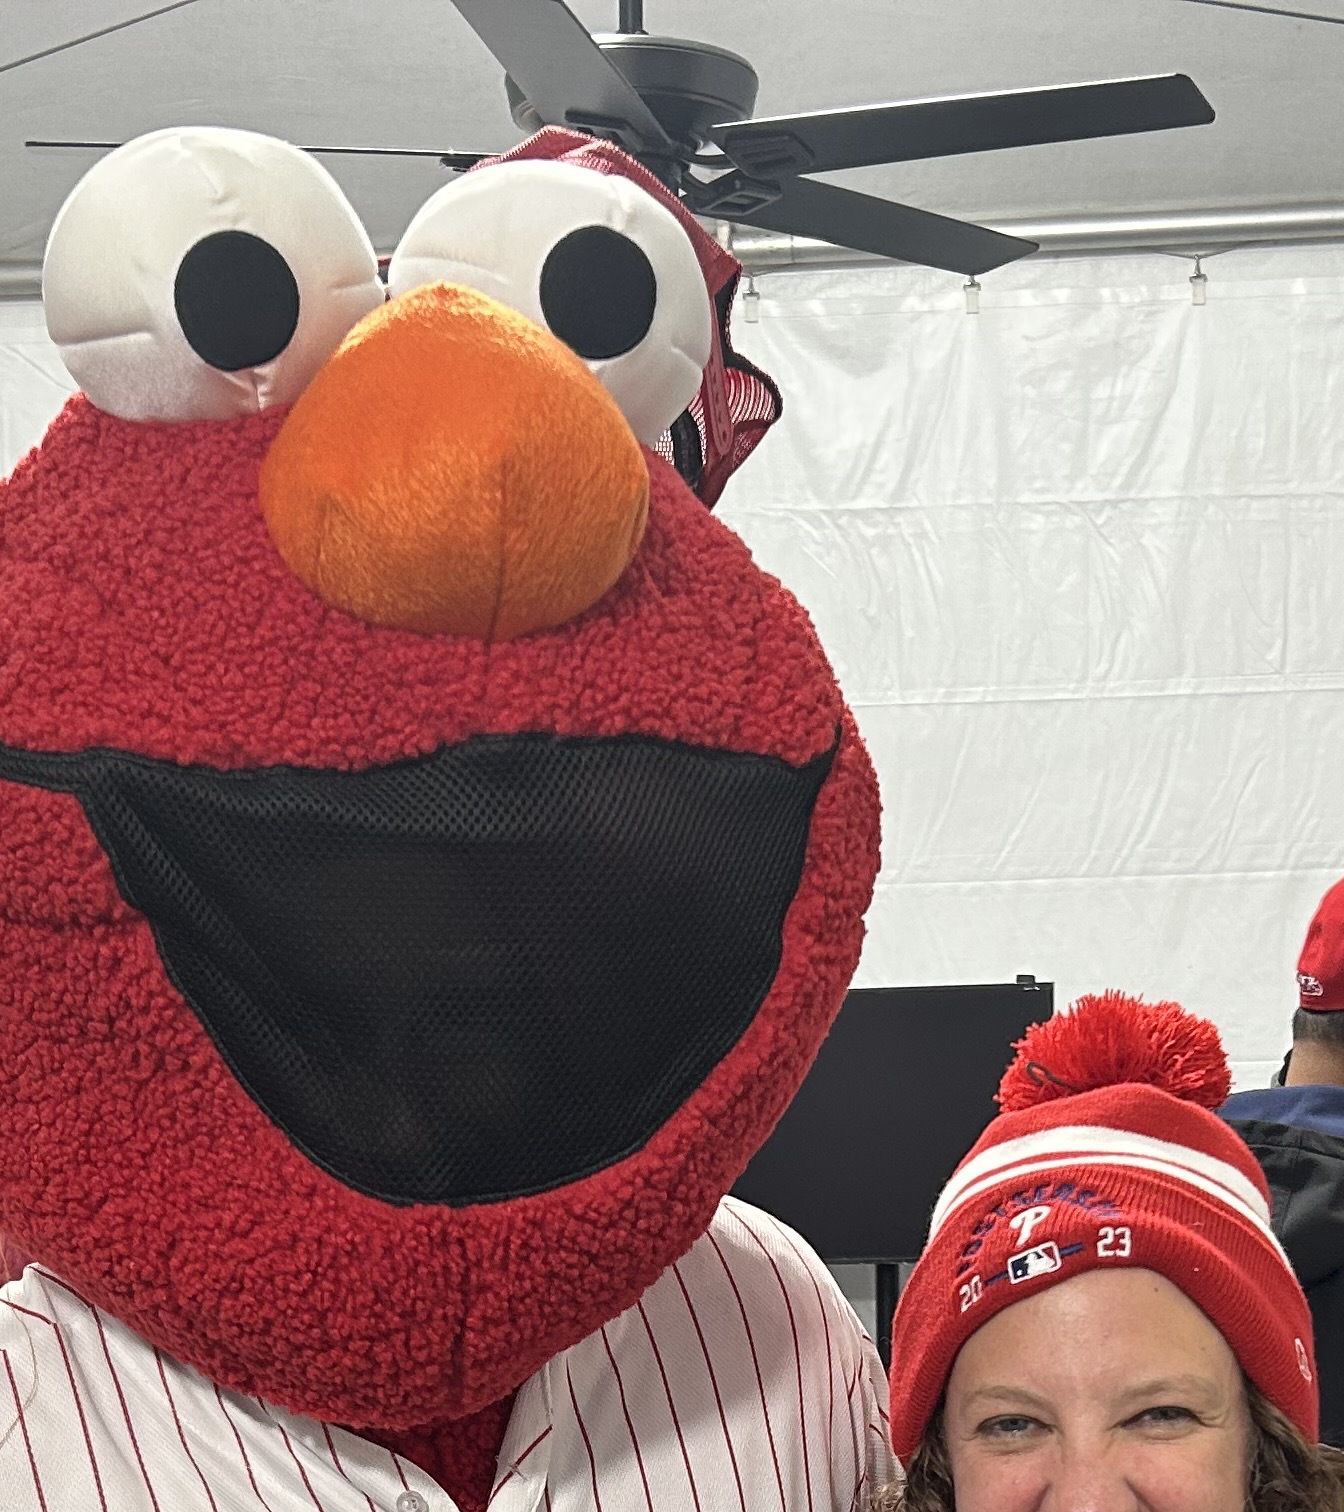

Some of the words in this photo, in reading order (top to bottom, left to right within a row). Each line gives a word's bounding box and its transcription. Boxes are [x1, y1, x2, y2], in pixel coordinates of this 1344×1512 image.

[1009, 1205, 1051, 1247] P
[959, 1274, 983, 1313] 20
[1097, 1226, 1132, 1257] 23
